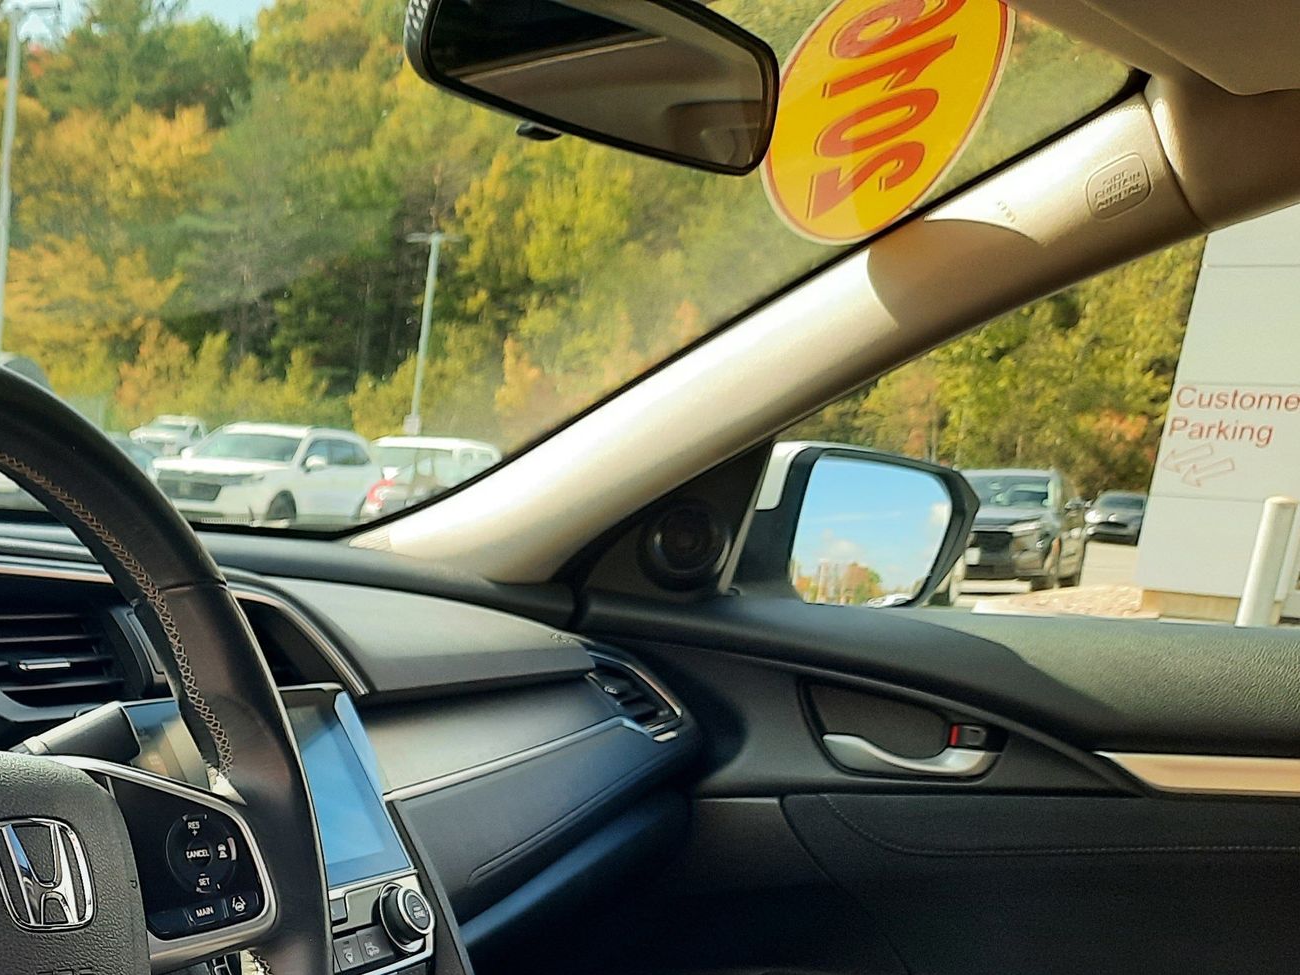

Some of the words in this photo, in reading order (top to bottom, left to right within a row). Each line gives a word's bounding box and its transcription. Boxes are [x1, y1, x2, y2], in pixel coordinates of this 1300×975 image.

[1168, 415, 1274, 449] Parking
[188, 821, 200, 830] RES
[186, 850, 210, 859] CANCEL
[199, 877, 210, 887] SET
[196, 907, 214, 918] MAIN
